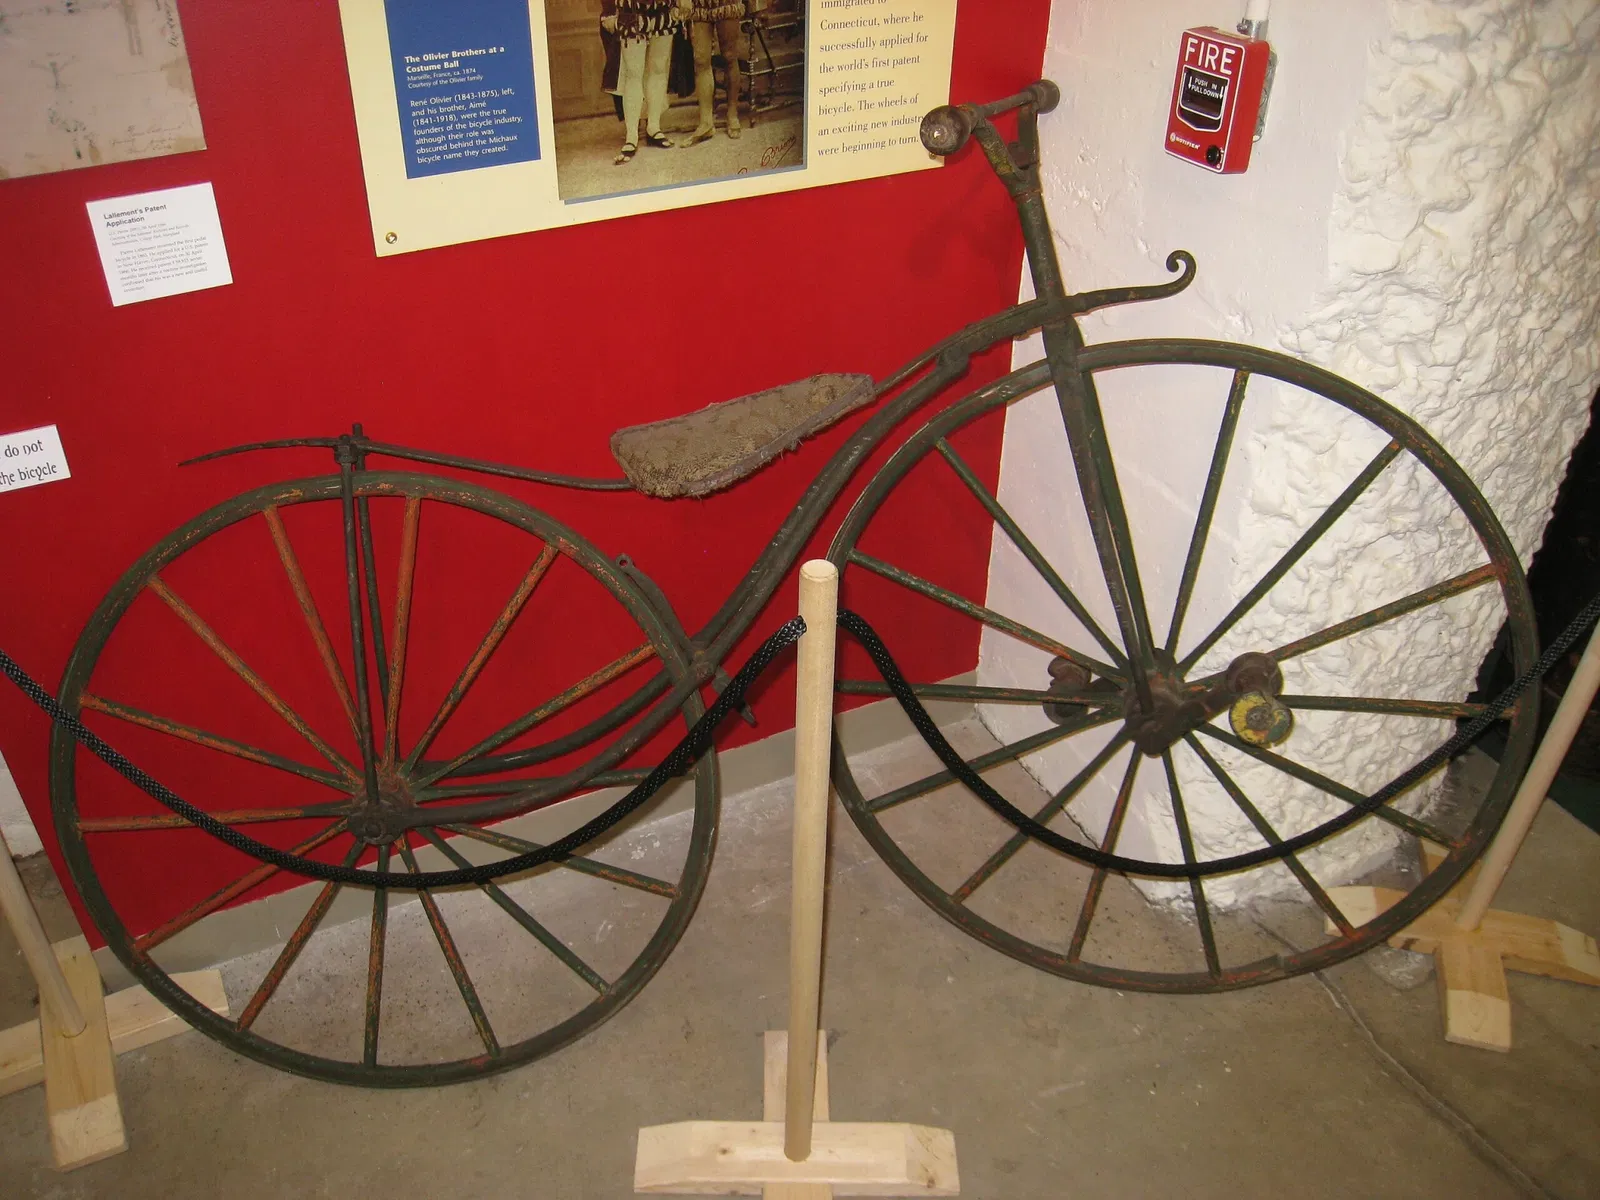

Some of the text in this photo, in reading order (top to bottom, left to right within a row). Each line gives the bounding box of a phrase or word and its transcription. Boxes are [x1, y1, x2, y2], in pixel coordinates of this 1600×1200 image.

[820, 12, 924, 30] Connecticut, where he
[820, 32, 928, 52] successfully applied for
[423, 52, 449, 61] Olivier
[452, 48, 486, 57] Brothers
[1184, 38, 1235, 75] FIRE
[406, 62, 441, 73] Costume
[819, 55, 920, 73] the world's first patent
[819, 79, 894, 97] specifying a true
[1191, 84, 1219, 99] PULL DOWN
[1195, 77, 1208, 89] PUSH
[410, 99, 427, 107] René
[430, 96, 452, 105] Olivier
[440, 104, 466, 113] brother,
[819, 93, 920, 116] bicycle. The wheels of
[414, 125, 444, 135] founders
[469, 118, 492, 128] bicycle
[495, 115, 522, 125] industry,
[818, 128, 829, 136] an
[832, 121, 868, 133] exciting
[871, 120, 888, 129] new
[416, 134, 446, 144] although
[416, 143, 448, 154] obscured
[450, 140, 473, 149] behind
[489, 134, 518, 144] Michaux
[818, 135, 918, 156] were beginning to turn.
[418, 144, 508, 164] bicycle name they created.
[145, 204, 167, 212] Patent
[106, 216, 145, 228] Application
[4, 440, 43, 458] do not
[18, 462, 57, 481] bicycle
